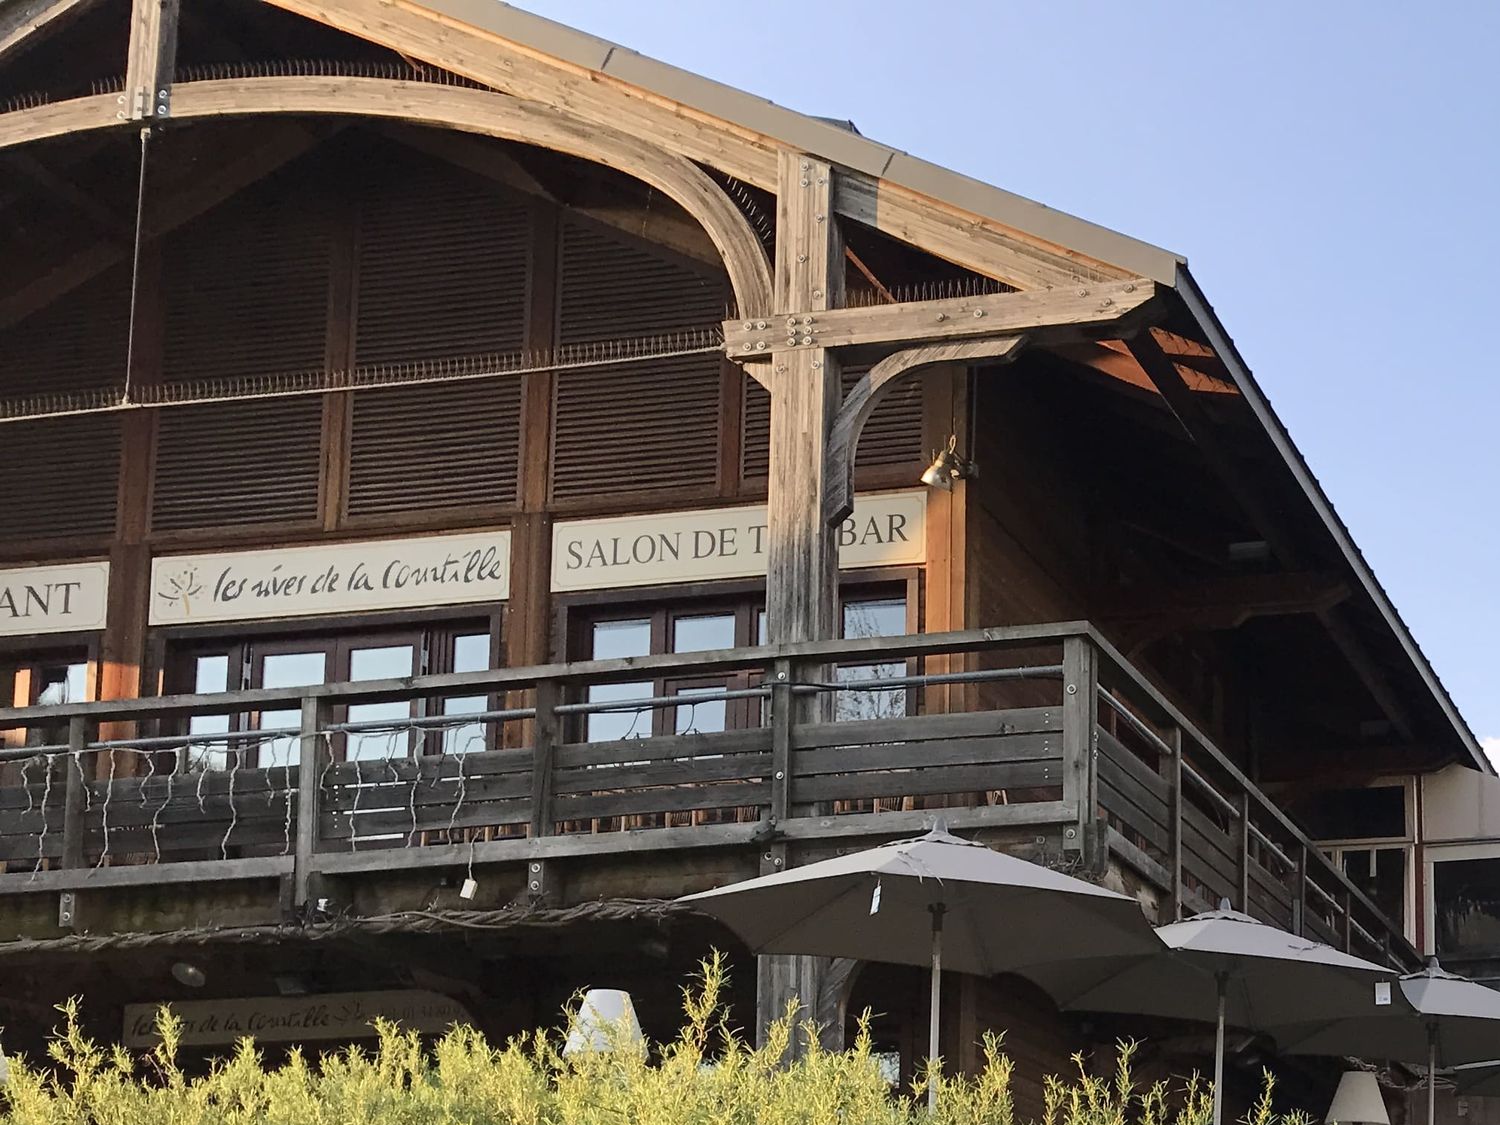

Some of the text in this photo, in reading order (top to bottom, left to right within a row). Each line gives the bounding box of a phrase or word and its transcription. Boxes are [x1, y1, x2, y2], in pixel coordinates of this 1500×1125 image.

[566, 532, 682, 570] SALON
[692, 527, 738, 559] DE
[839, 513, 909, 547] BAR
[0, 582, 80, 617] ANT
[213, 546, 502, 602] les rives de la Courtille
